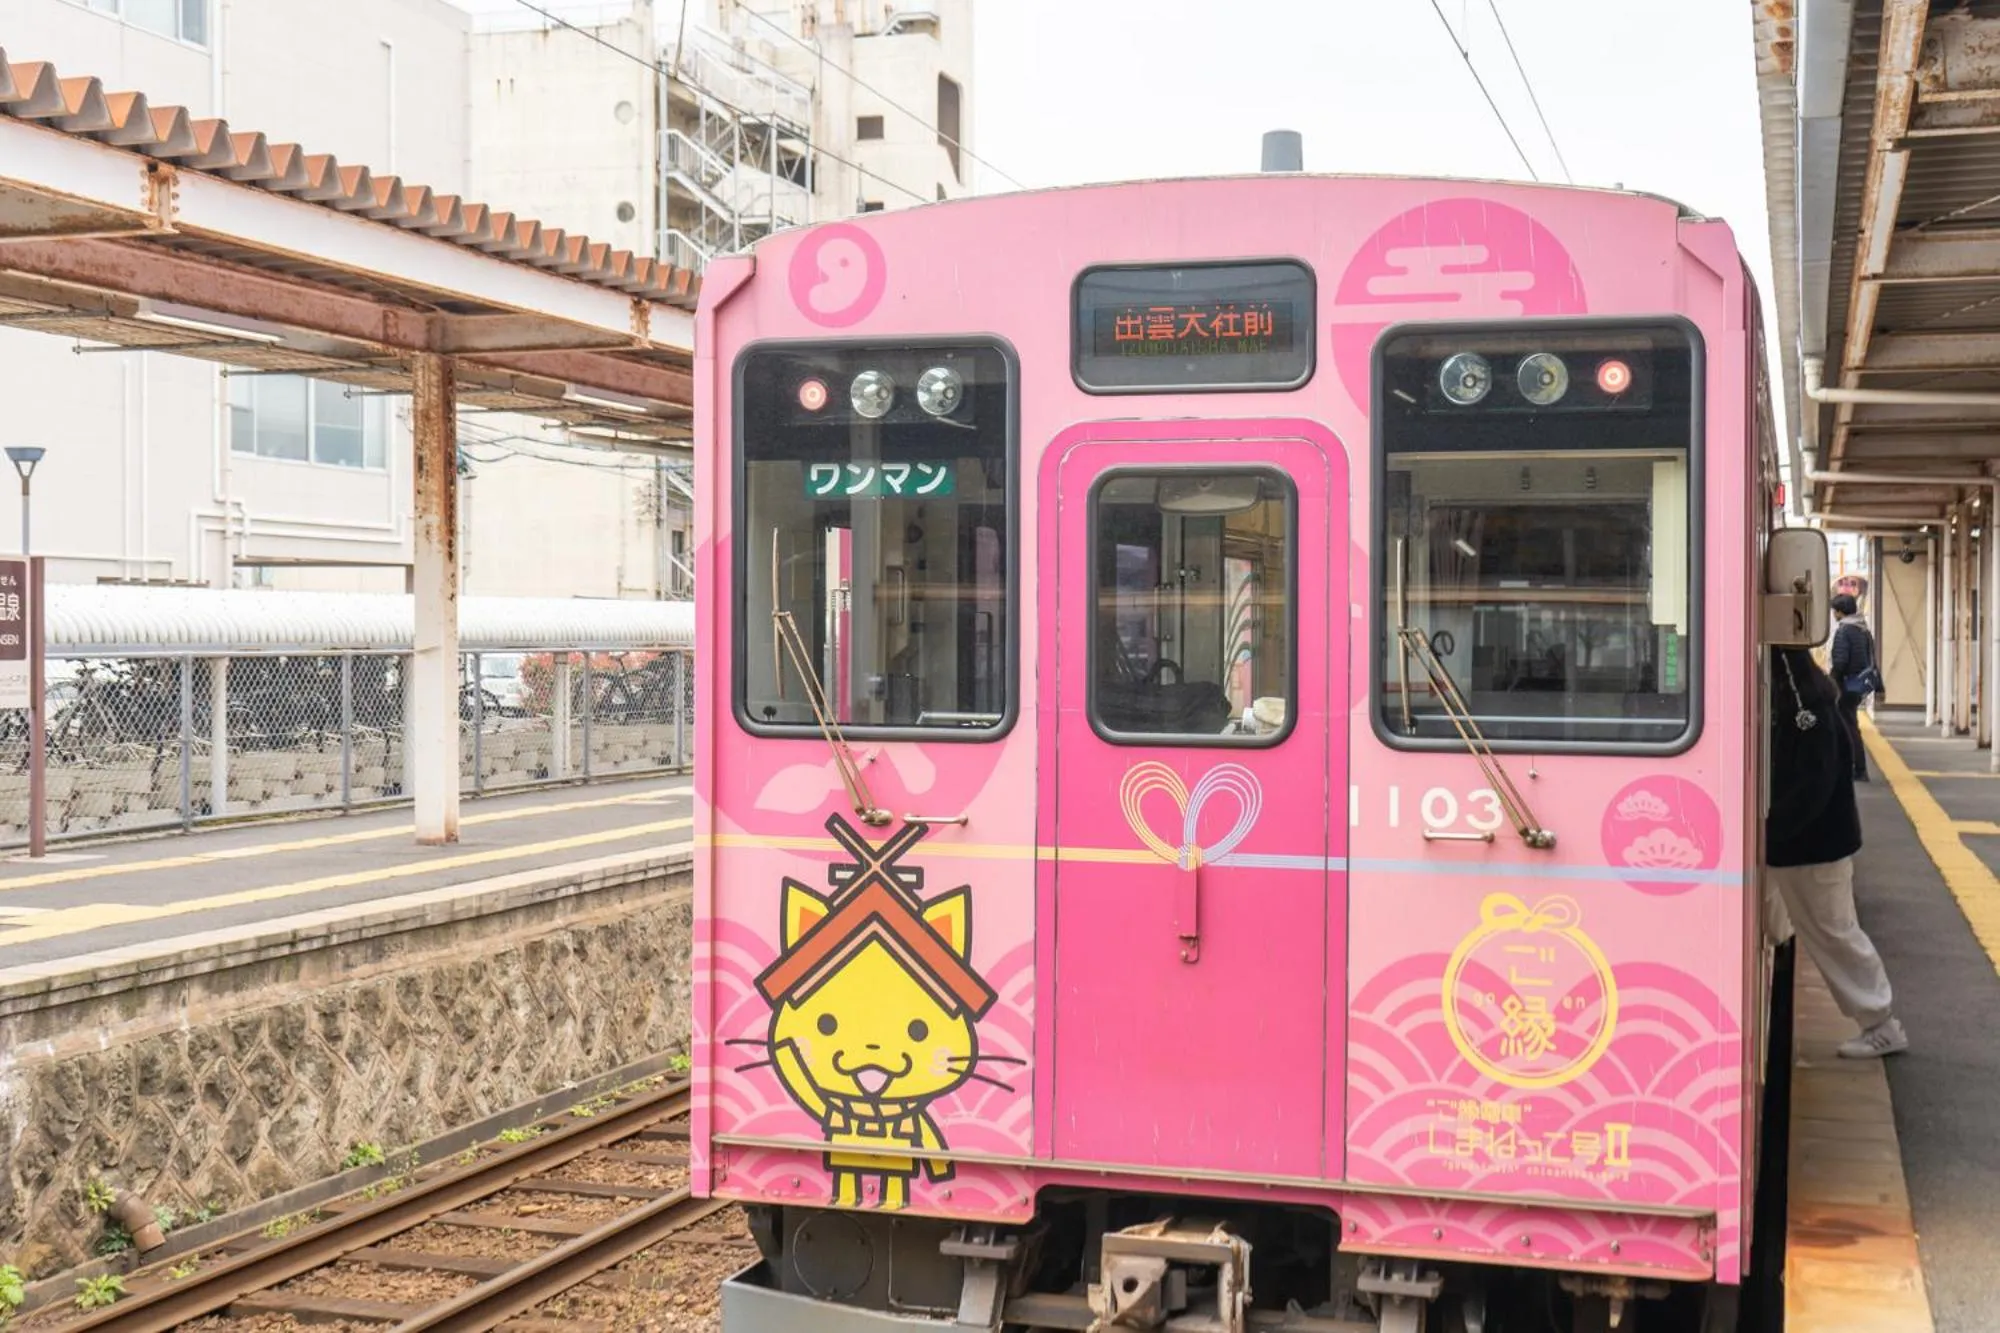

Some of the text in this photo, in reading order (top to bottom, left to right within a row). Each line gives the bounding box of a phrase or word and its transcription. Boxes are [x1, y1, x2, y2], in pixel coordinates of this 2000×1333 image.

[1115, 303, 1273, 341] 出雲大社前
[810, 462, 946, 494] ワンマン
[1350, 785, 1504, 830] 1103
